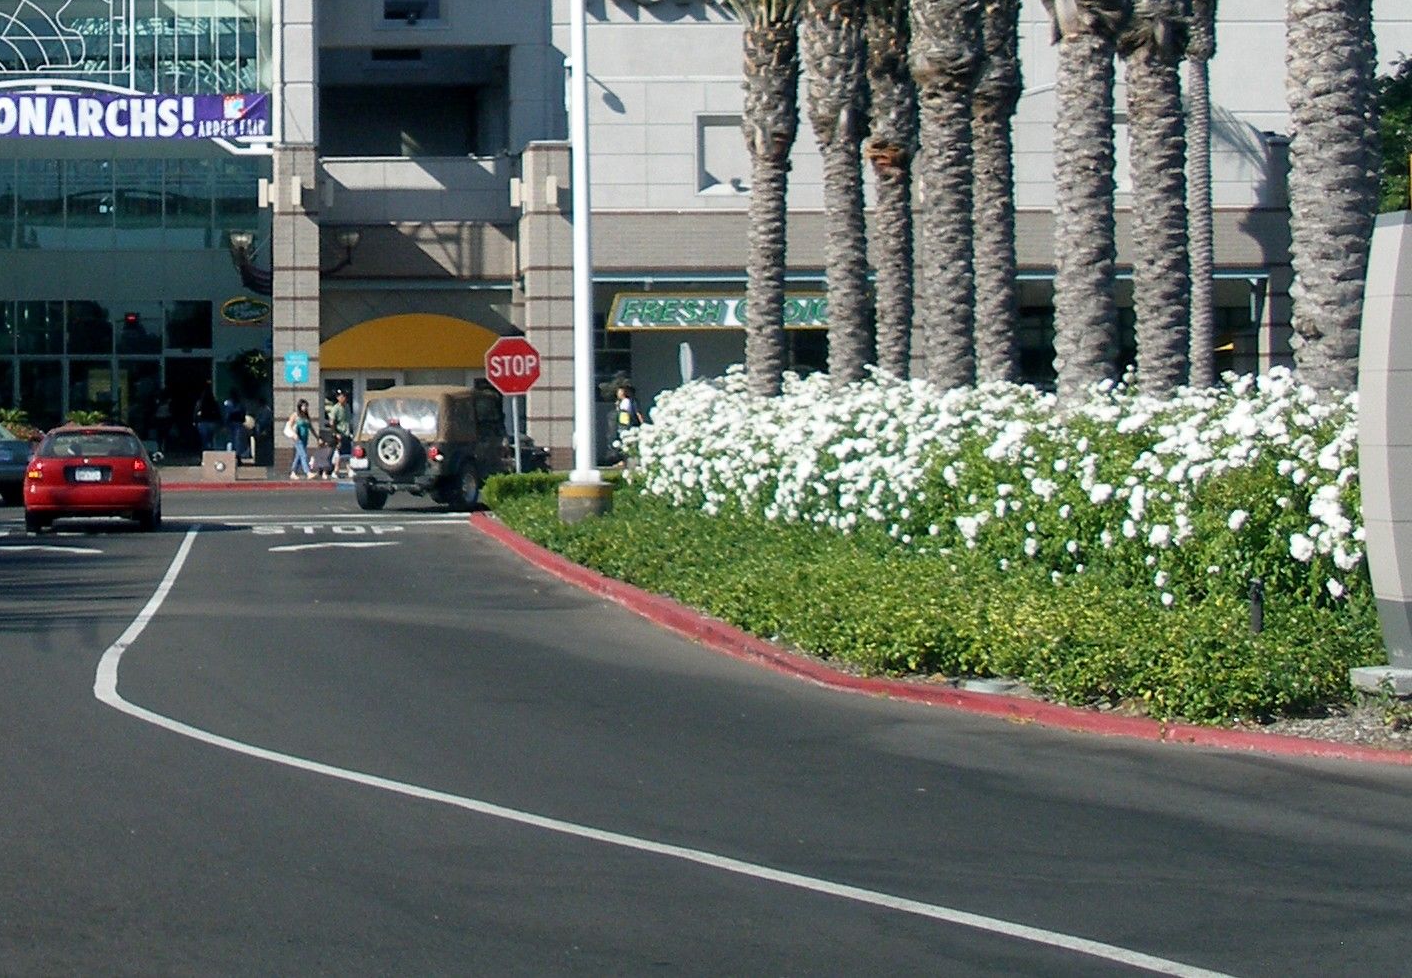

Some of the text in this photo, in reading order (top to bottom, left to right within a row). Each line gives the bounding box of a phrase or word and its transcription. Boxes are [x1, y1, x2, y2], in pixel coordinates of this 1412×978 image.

[622, 299, 829, 322] FRESH COIC
[490, 354, 537, 377] STOP
[252, 525, 404, 535] STOP
